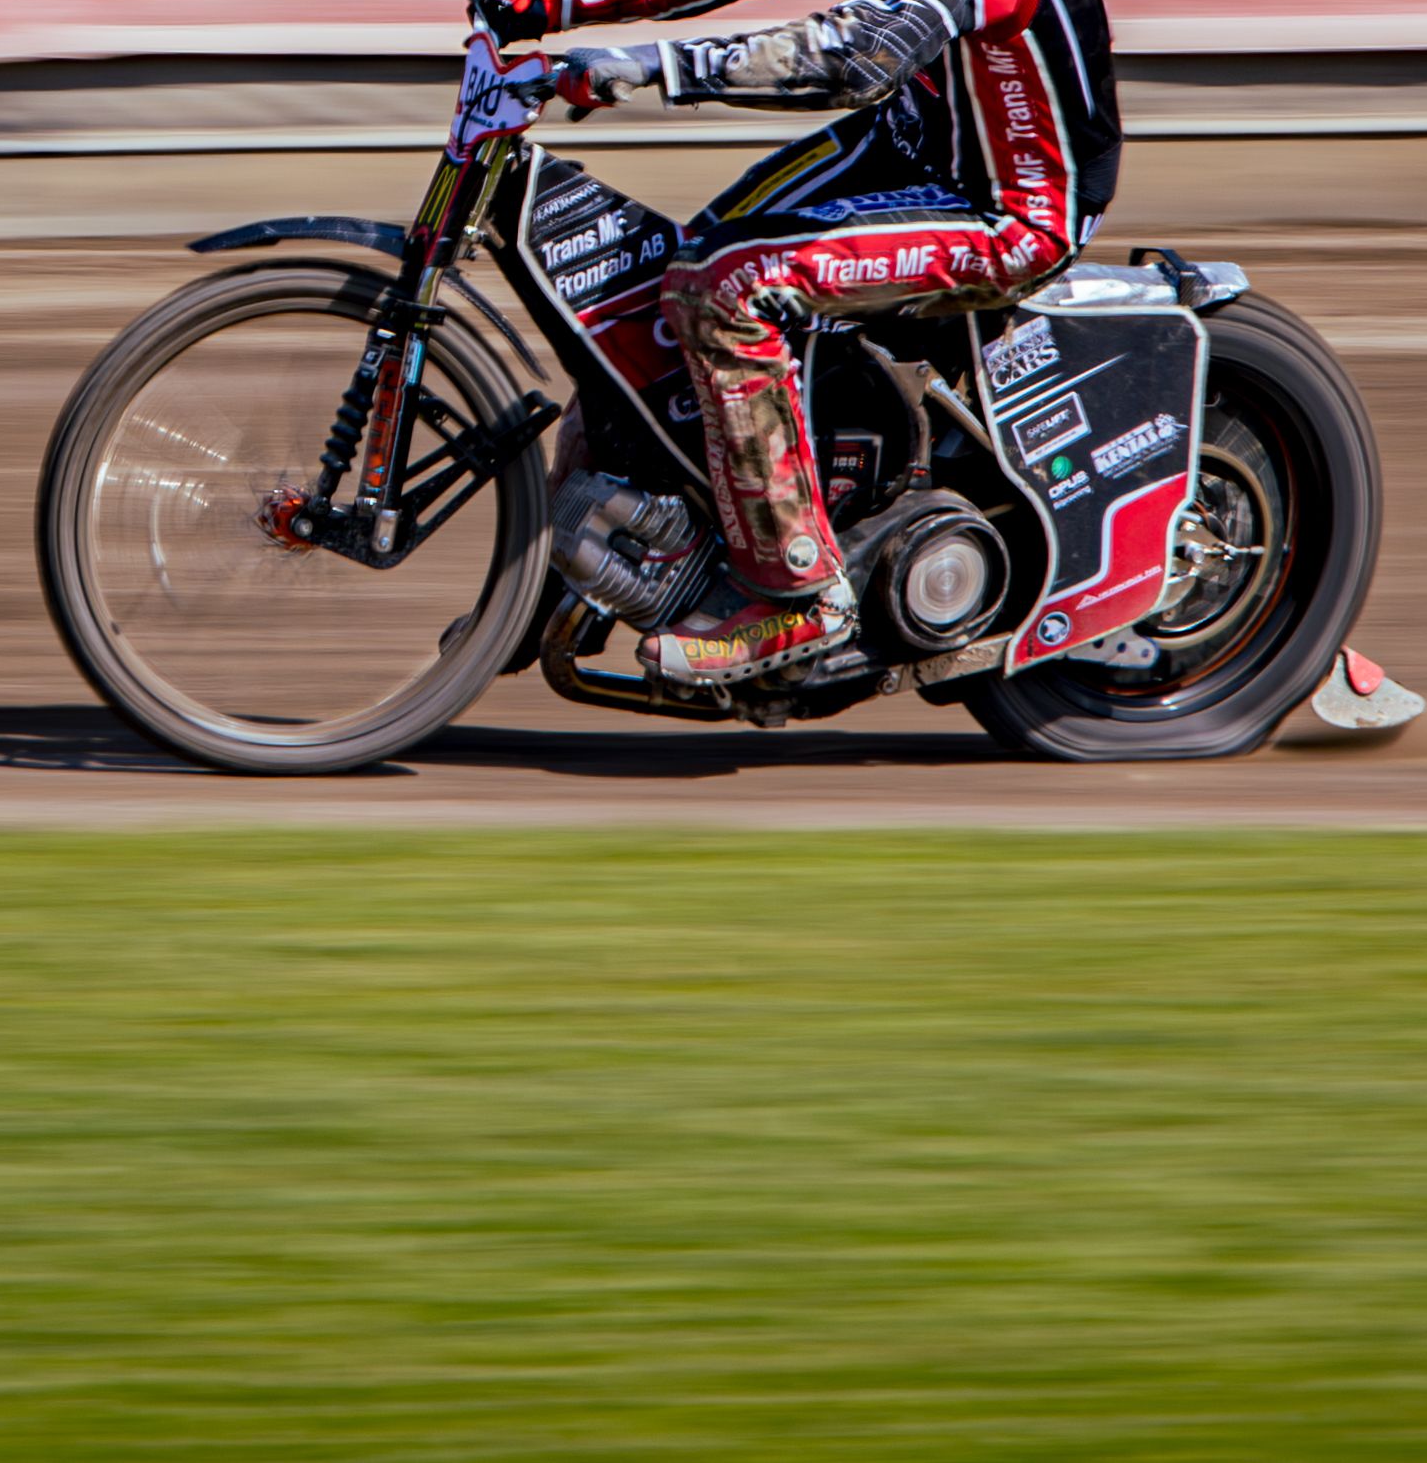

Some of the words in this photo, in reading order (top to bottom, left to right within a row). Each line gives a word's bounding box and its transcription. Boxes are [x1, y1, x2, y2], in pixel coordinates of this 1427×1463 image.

[981, 41, 1017, 75] MF
[1000, 80, 1038, 142] Trans
[541, 228, 598, 270] Trans
[554, 250, 634, 299] Frontab
[639, 233, 665, 265] AB
[812, 253, 890, 282] Trans
[895, 245, 939, 277] MF
[991, 345, 1060, 389] CARS
